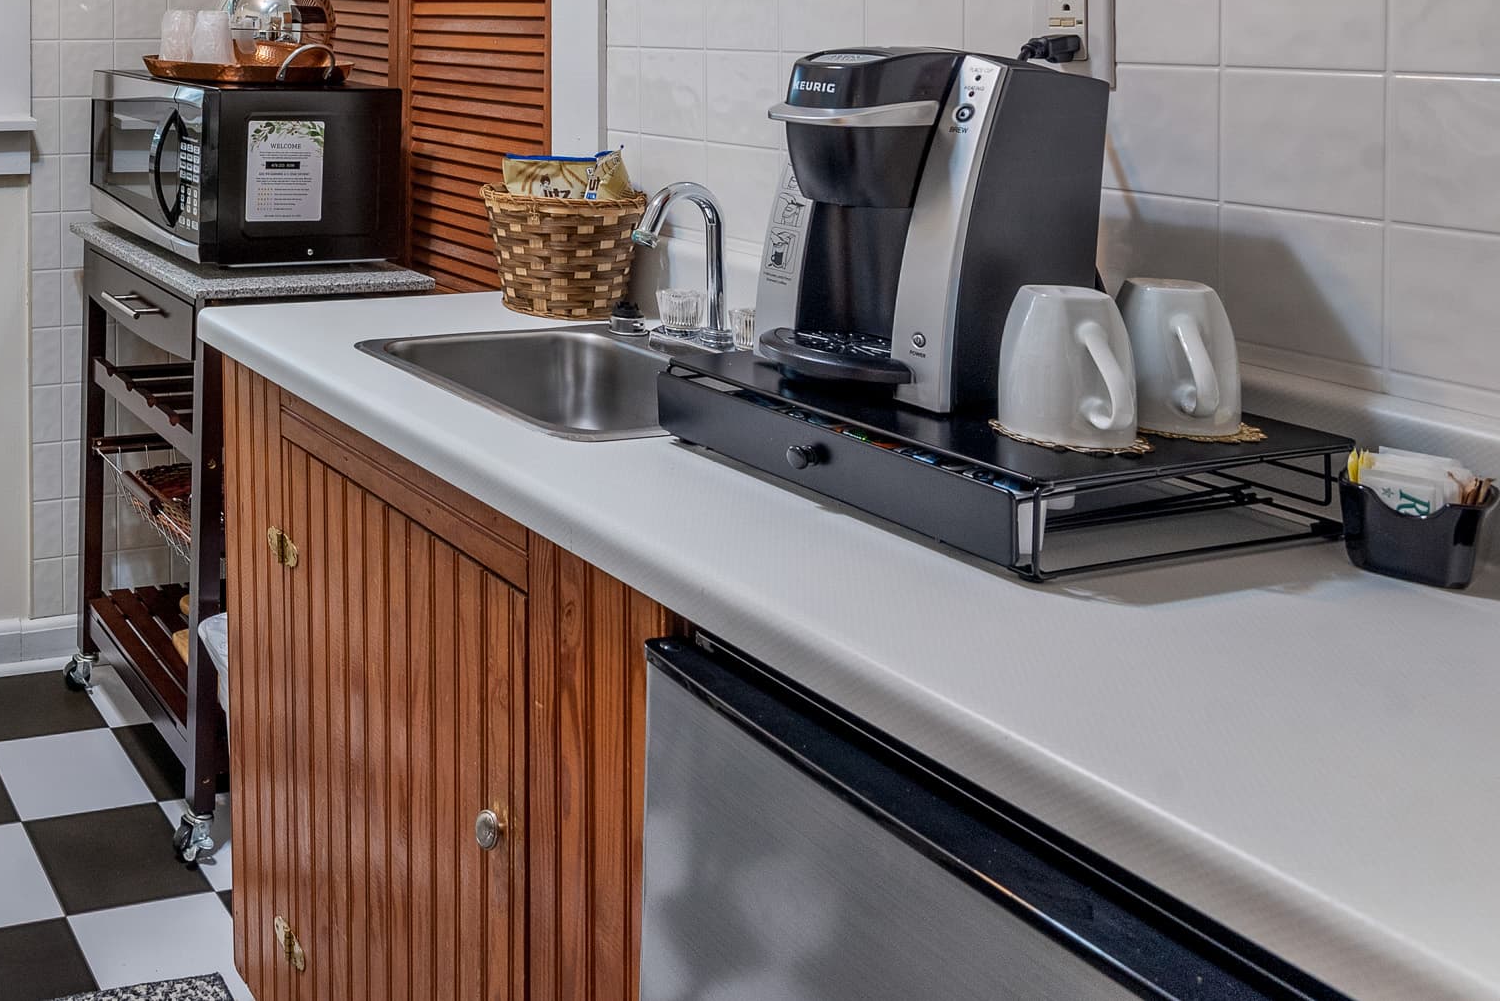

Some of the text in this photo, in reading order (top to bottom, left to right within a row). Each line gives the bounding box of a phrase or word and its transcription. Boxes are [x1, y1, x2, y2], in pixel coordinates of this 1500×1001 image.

[792, 81, 836, 94] KEURIG
[948, 126, 969, 134] BREW
[909, 350, 926, 358] POWER
